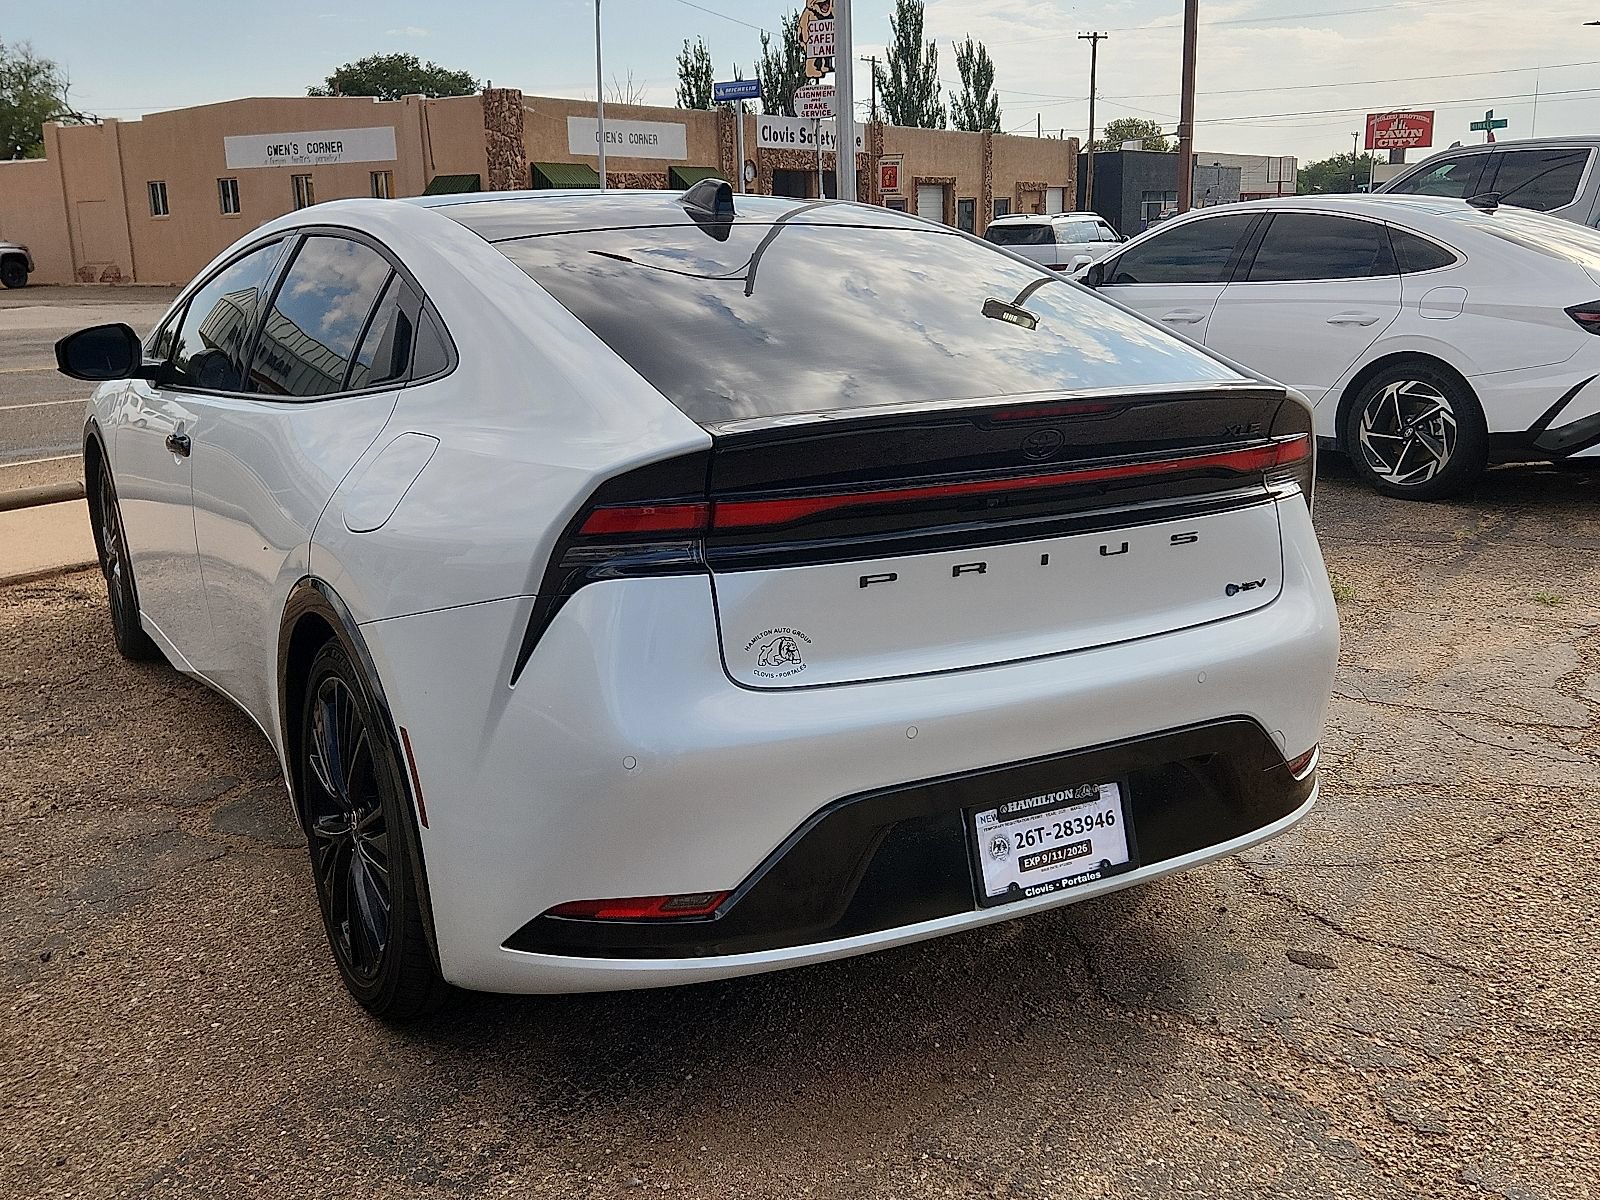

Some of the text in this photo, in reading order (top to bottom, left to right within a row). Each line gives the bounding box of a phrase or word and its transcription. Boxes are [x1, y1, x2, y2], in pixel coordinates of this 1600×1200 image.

[808, 22, 835, 33] CLOVI
[808, 33, 835, 45] SAFET
[725, 85, 757, 93] MICHELIN
[794, 90, 836, 99] ALIGNMENT
[803, 102, 828, 110] BRAKE
[800, 109, 832, 118] SERVICE
[628, 133, 658, 145] CORNER
[761, 125, 795, 143] Clovis
[799, 127, 837, 150] Safety
[1375, 128, 1424, 139] PAWN
[266, 140, 344, 157] GWEN'S CORNER
[1377, 137, 1420, 147] CITY
[1223, 422, 1261, 436] XLE
[859, 530, 1199, 588] PRIUS
[744, 629, 773, 652] HAMILTON
[792, 629, 812, 644] GROUP
[753, 663, 807, 679] CLOVIS PORTALES
[1007, 788, 1074, 813] HAMILTON
[1014, 809, 1116, 850] 26T-283946
[1023, 855, 1041, 868] EXP
[1041, 843, 1088, 864] 9/11/2026
[1024, 871, 1102, 897] Clovis Portales
